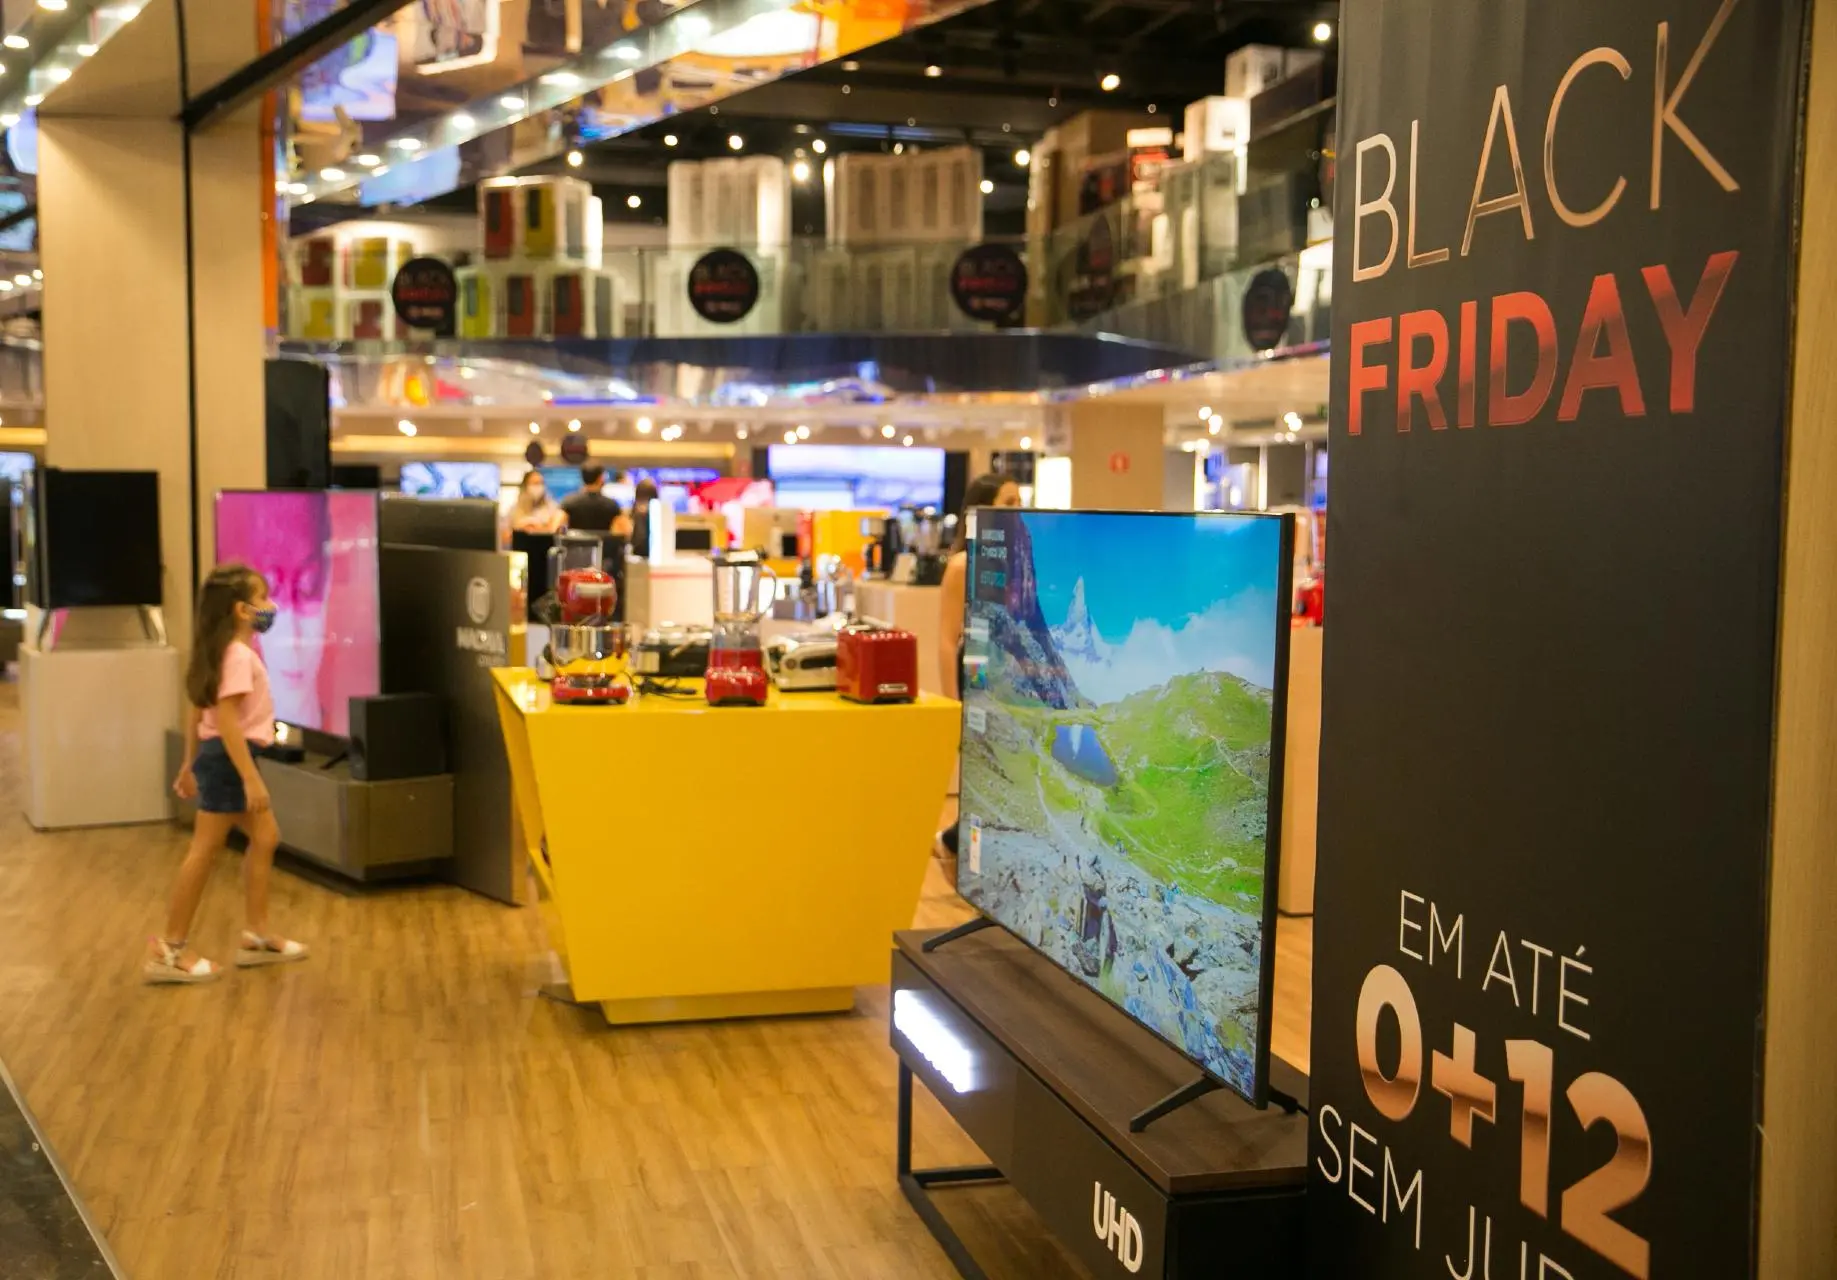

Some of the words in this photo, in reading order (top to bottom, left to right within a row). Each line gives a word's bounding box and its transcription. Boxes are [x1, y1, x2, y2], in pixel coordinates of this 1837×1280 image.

[1353, 0, 1740, 282] BLACK
[1348, 251, 1739, 435] FRIDAY
[1400, 889, 1464, 979] EM
[1482, 930, 1594, 1041] ATÉ
[1317, 1104, 1423, 1250] SEM
[1356, 964, 1652, 1280] 0+12
[1093, 1181, 1143, 1273] UHD
